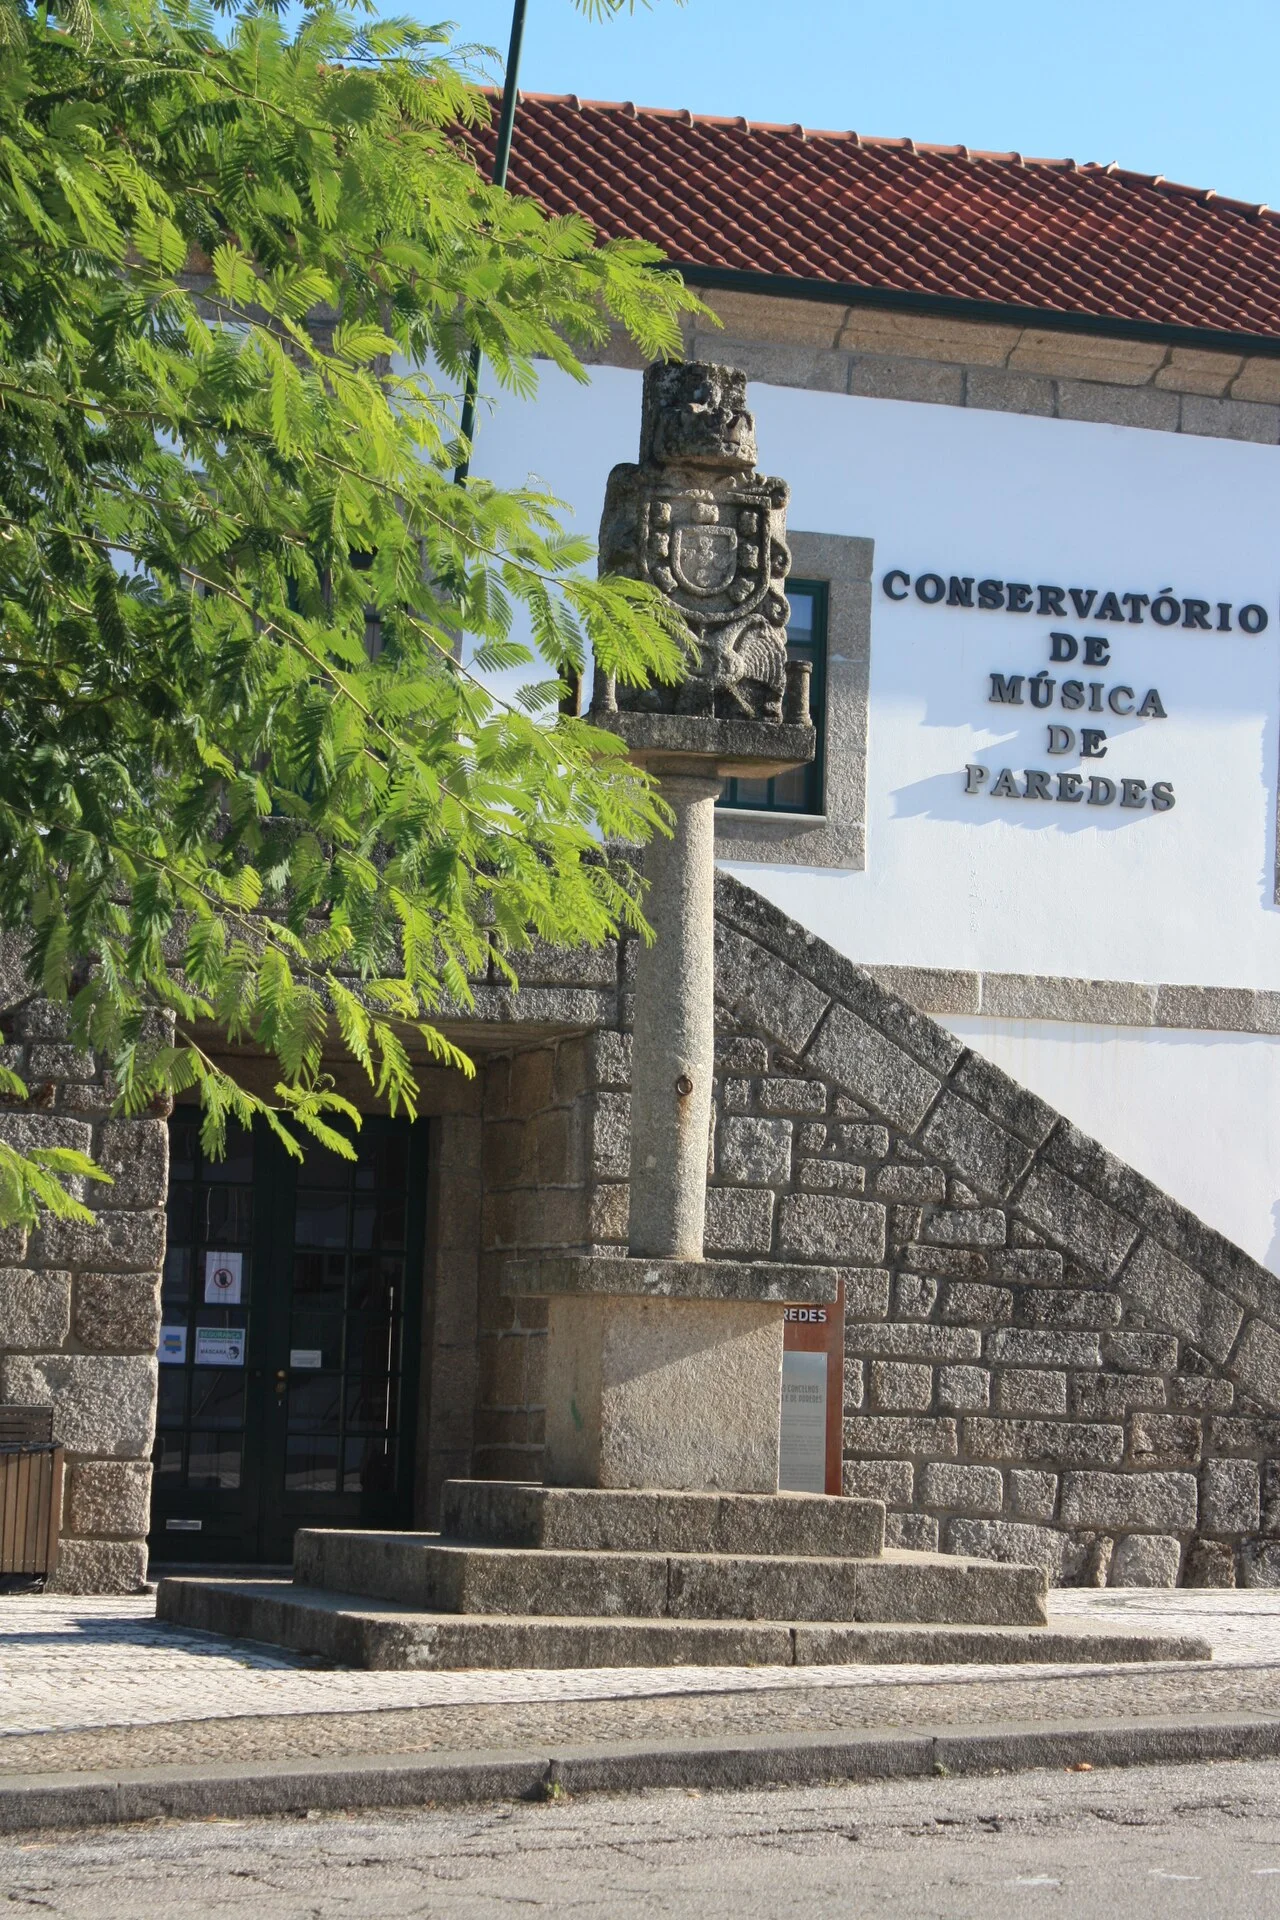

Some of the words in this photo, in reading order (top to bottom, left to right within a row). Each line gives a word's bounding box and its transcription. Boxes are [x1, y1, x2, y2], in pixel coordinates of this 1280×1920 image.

[882, 570, 1269, 634] CONSERVATÓRIO
[1049, 632, 1111, 666] DE
[989, 671, 1168, 718] MÚSICA
[1047, 725, 1108, 758] DE
[965, 764, 1176, 811] PAREDES
